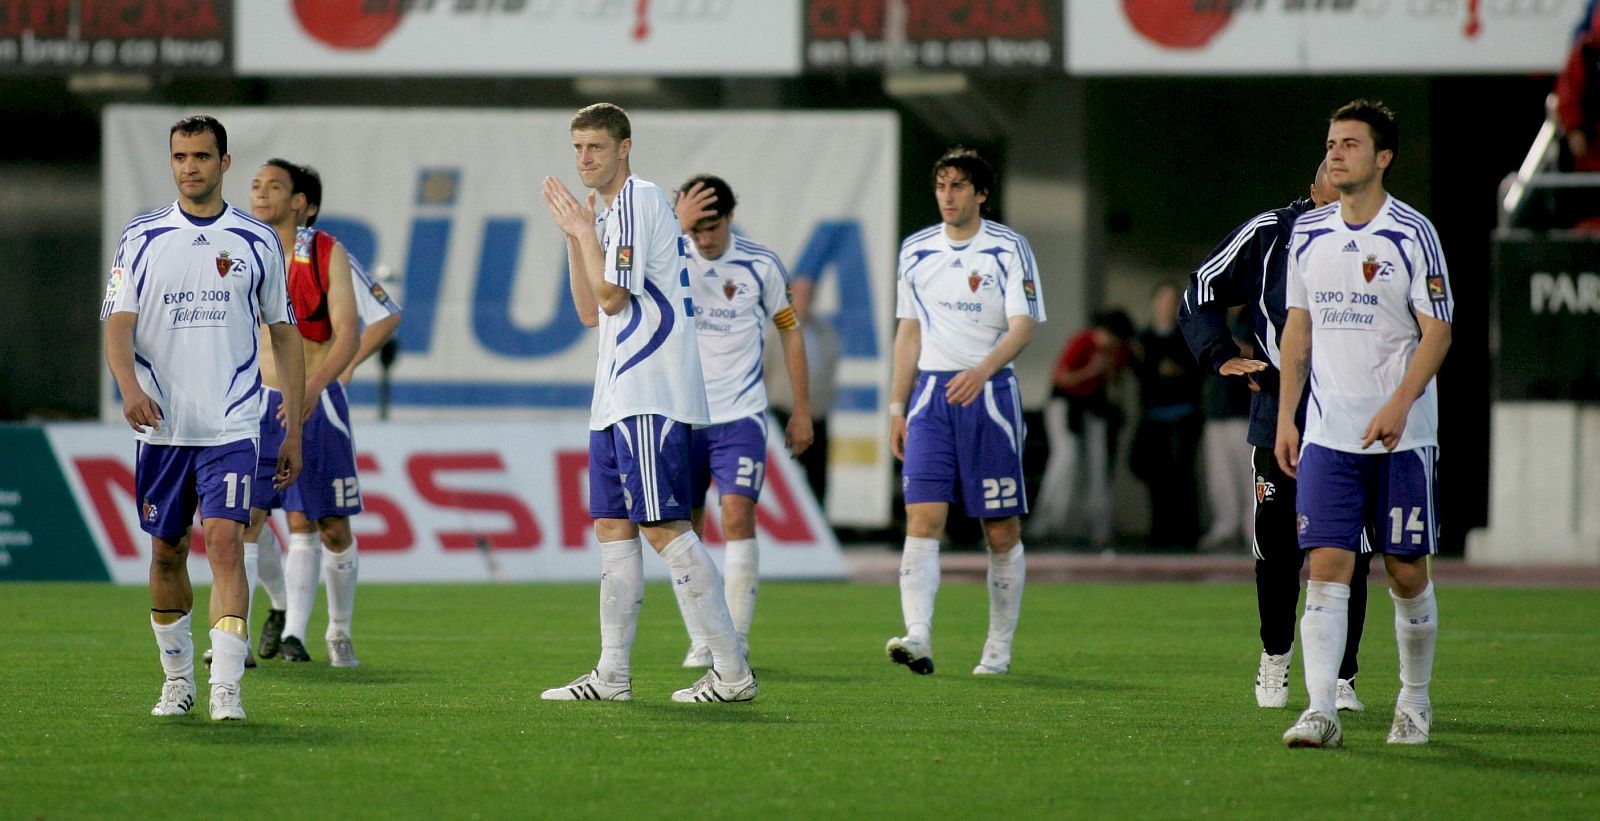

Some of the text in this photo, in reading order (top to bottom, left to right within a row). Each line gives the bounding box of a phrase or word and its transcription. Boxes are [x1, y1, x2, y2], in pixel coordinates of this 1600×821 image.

[163, 290, 230, 305] EXPO 2008
[709, 307, 737, 319] 2008
[736, 456, 764, 491] 21
[223, 472, 251, 509] 11
[331, 476, 359, 507] 12
[982, 477, 1018, 509] 22
[1389, 506, 1424, 544] 14
